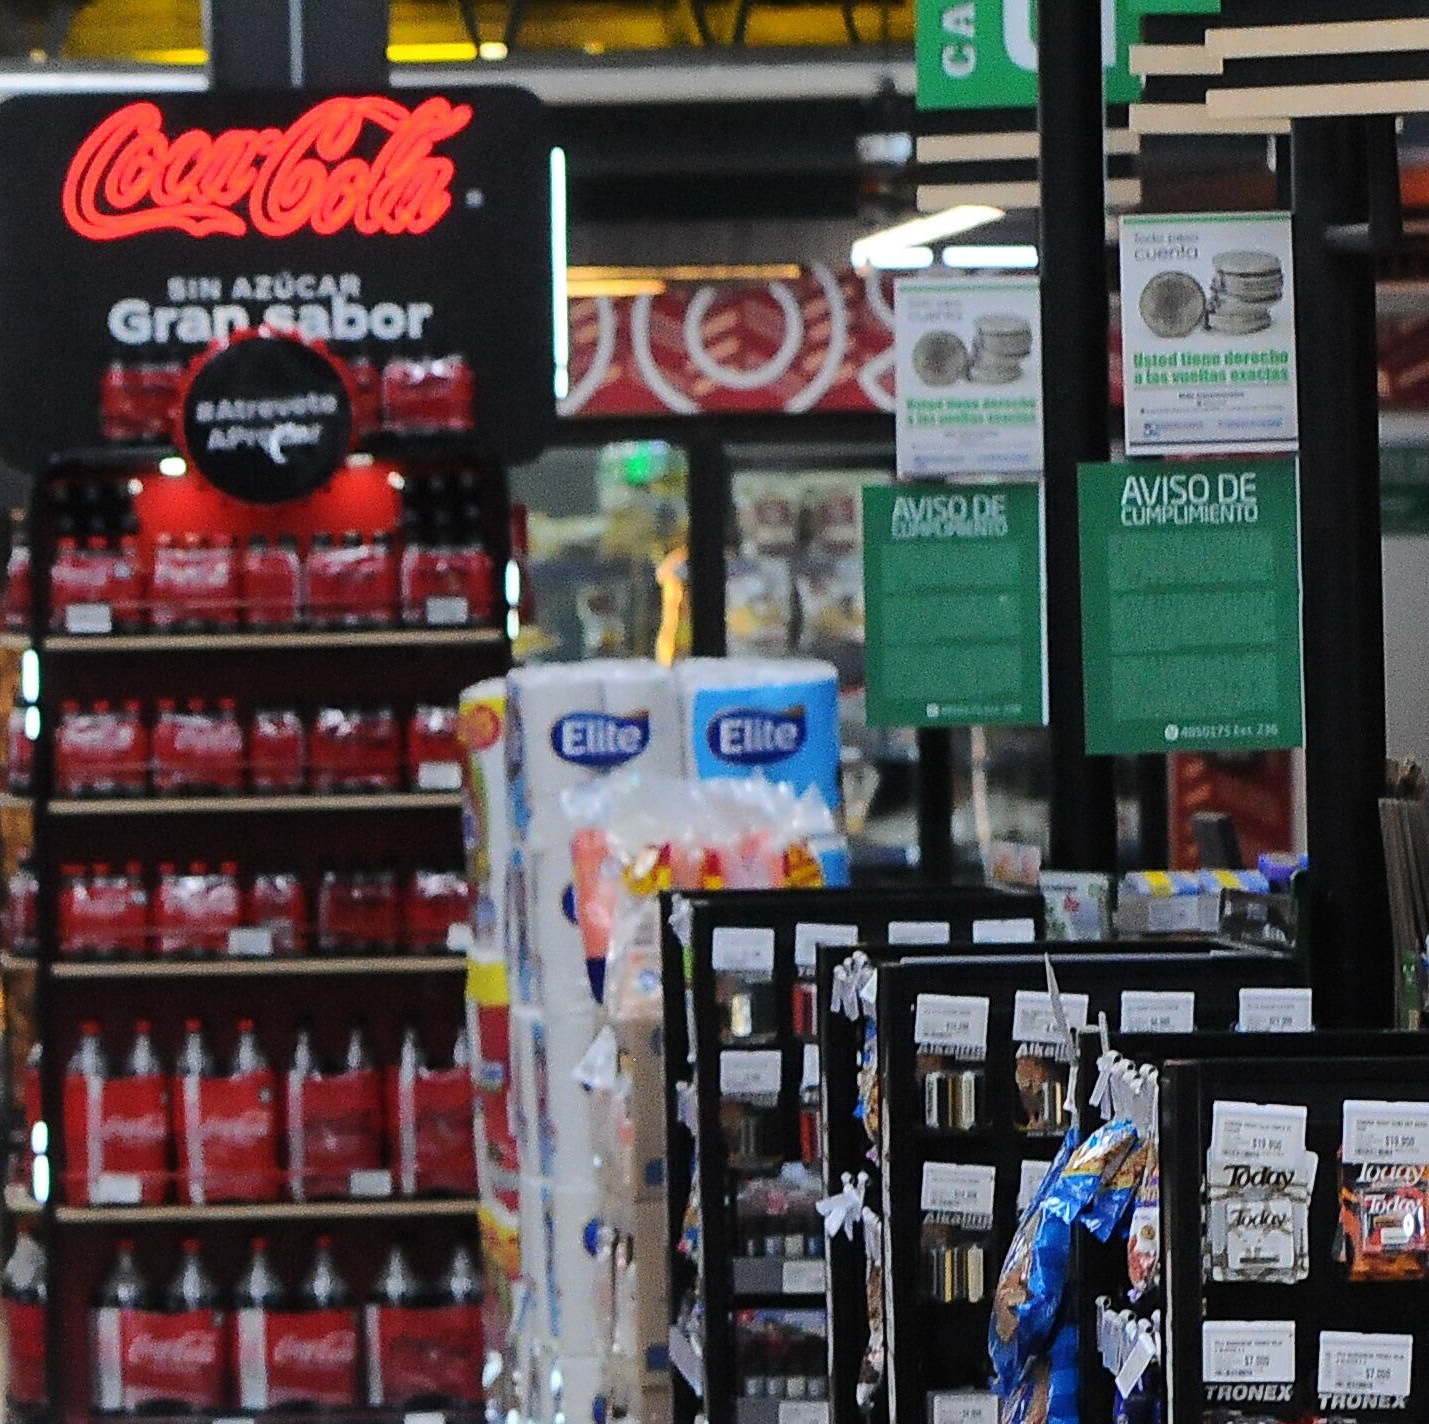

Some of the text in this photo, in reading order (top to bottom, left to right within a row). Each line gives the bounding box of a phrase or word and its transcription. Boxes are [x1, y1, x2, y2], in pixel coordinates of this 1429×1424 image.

[167, 275, 223, 301] SIN
[107, 294, 434, 346] Gran sabor
[1121, 472, 1257, 506] AVISO DE
[892, 494, 1006, 520] AVISO DE
[1120, 502, 1259, 526] CUMPLIMIENTO
[561, 719, 642, 757] Elite
[718, 716, 799, 756] Elite
[1224, 1164, 1295, 1190] Today
[1354, 1162, 1426, 1186] Today
[1230, 1208, 1287, 1228] Today
[1205, 1384, 1294, 1402] TRONEX
[1318, 1392, 1409, 1411] TRONEX
